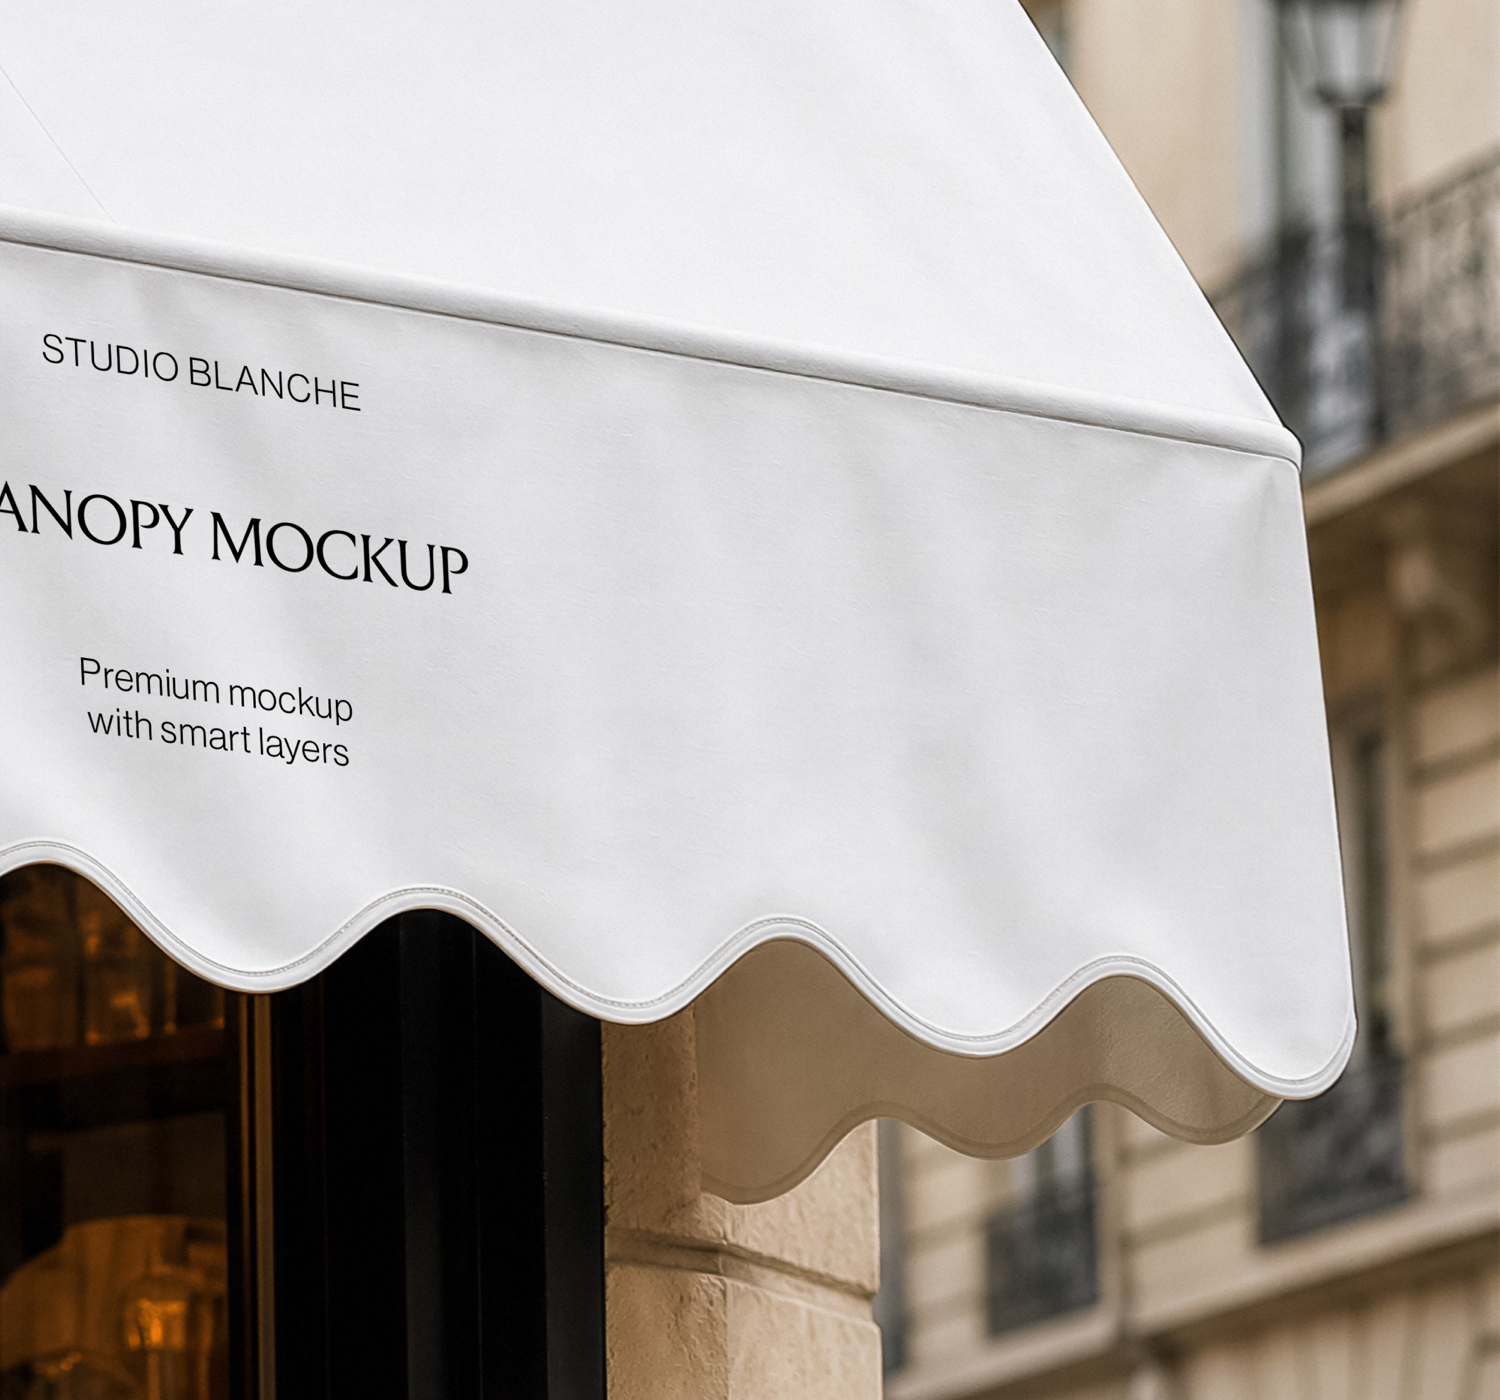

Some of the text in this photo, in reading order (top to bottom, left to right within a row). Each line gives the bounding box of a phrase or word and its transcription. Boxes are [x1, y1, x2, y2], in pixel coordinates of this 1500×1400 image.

[42, 333, 361, 412] STUDIO BLANCHE
[210, 511, 469, 595] MOCKUP
[80, 656, 353, 726] Premium mockup
[87, 707, 350, 767] with smart layers
